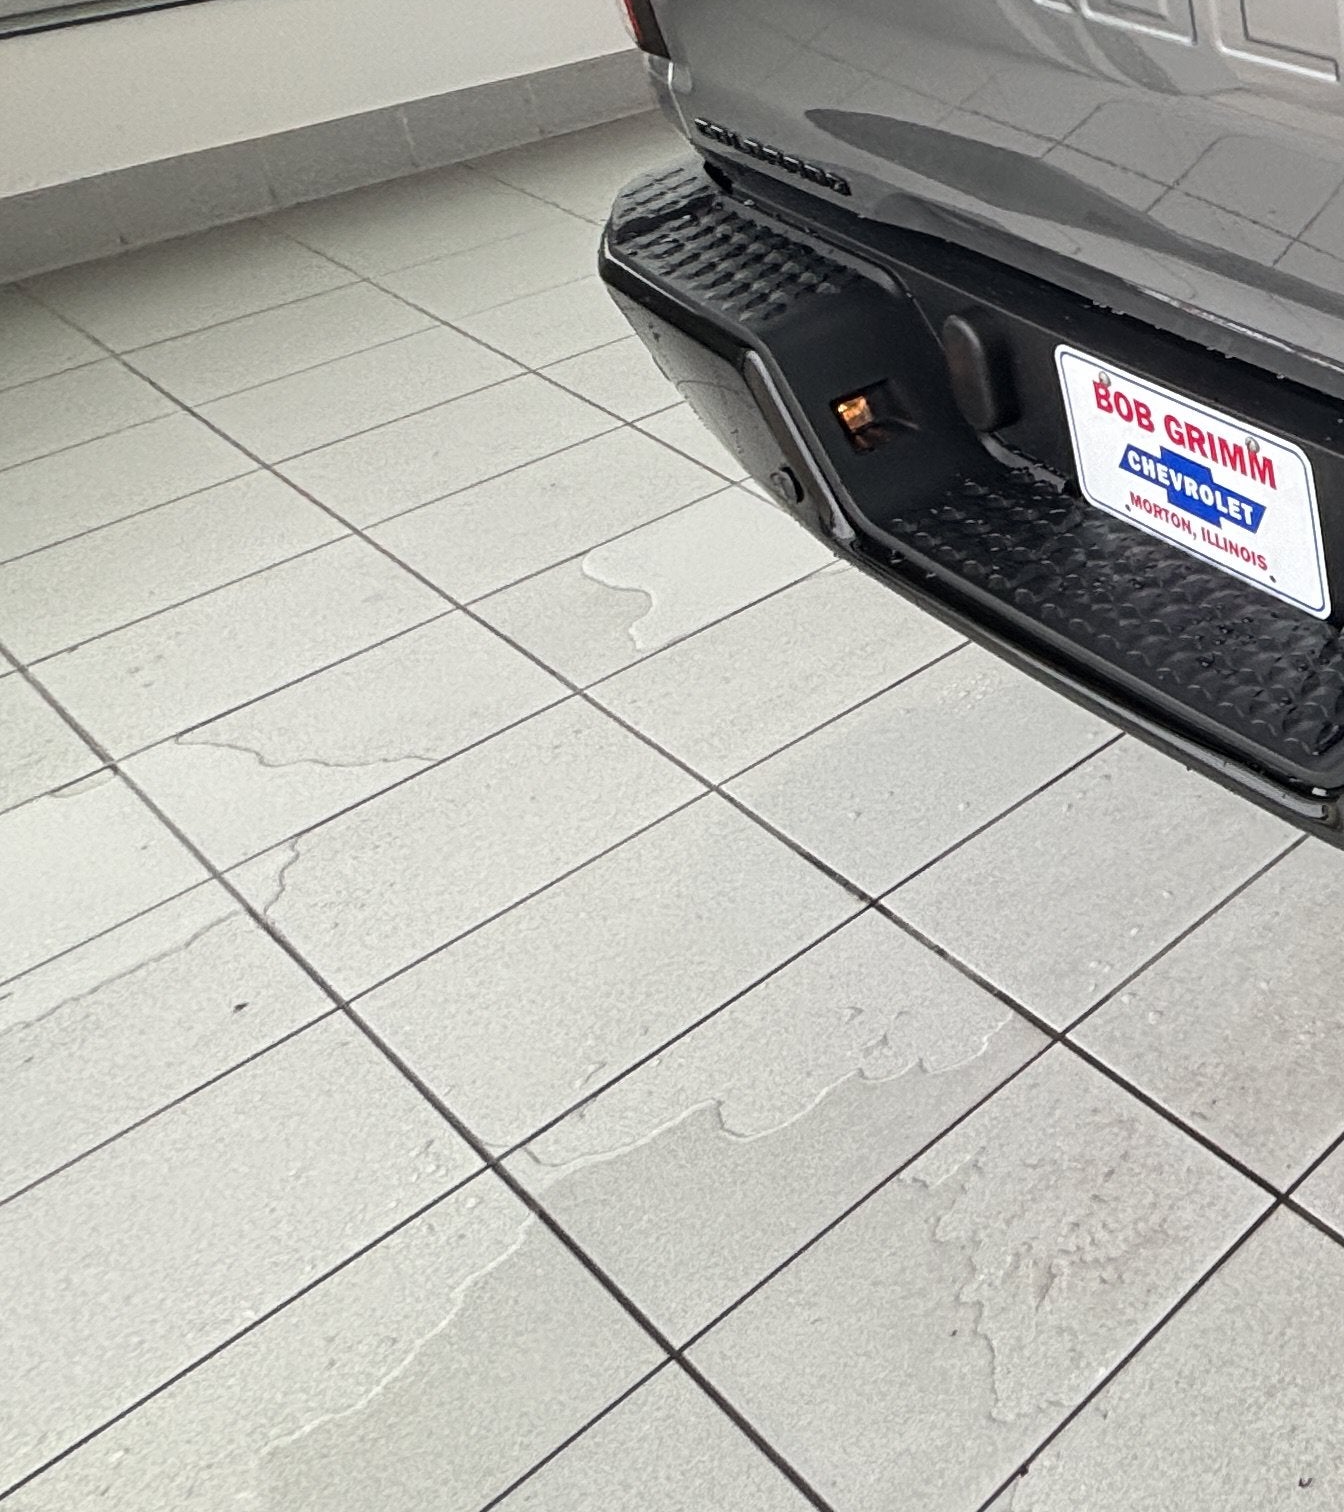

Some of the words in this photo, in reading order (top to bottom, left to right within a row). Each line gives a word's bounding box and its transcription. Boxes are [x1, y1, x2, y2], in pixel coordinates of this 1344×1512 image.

[1092, 380, 1155, 434] BOB
[1163, 414, 1278, 491] GRIMM
[1126, 449, 1254, 526] CHEVROLET
[1129, 491, 1197, 540] MORTON,
[1200, 526, 1268, 571] ILLINOIS
